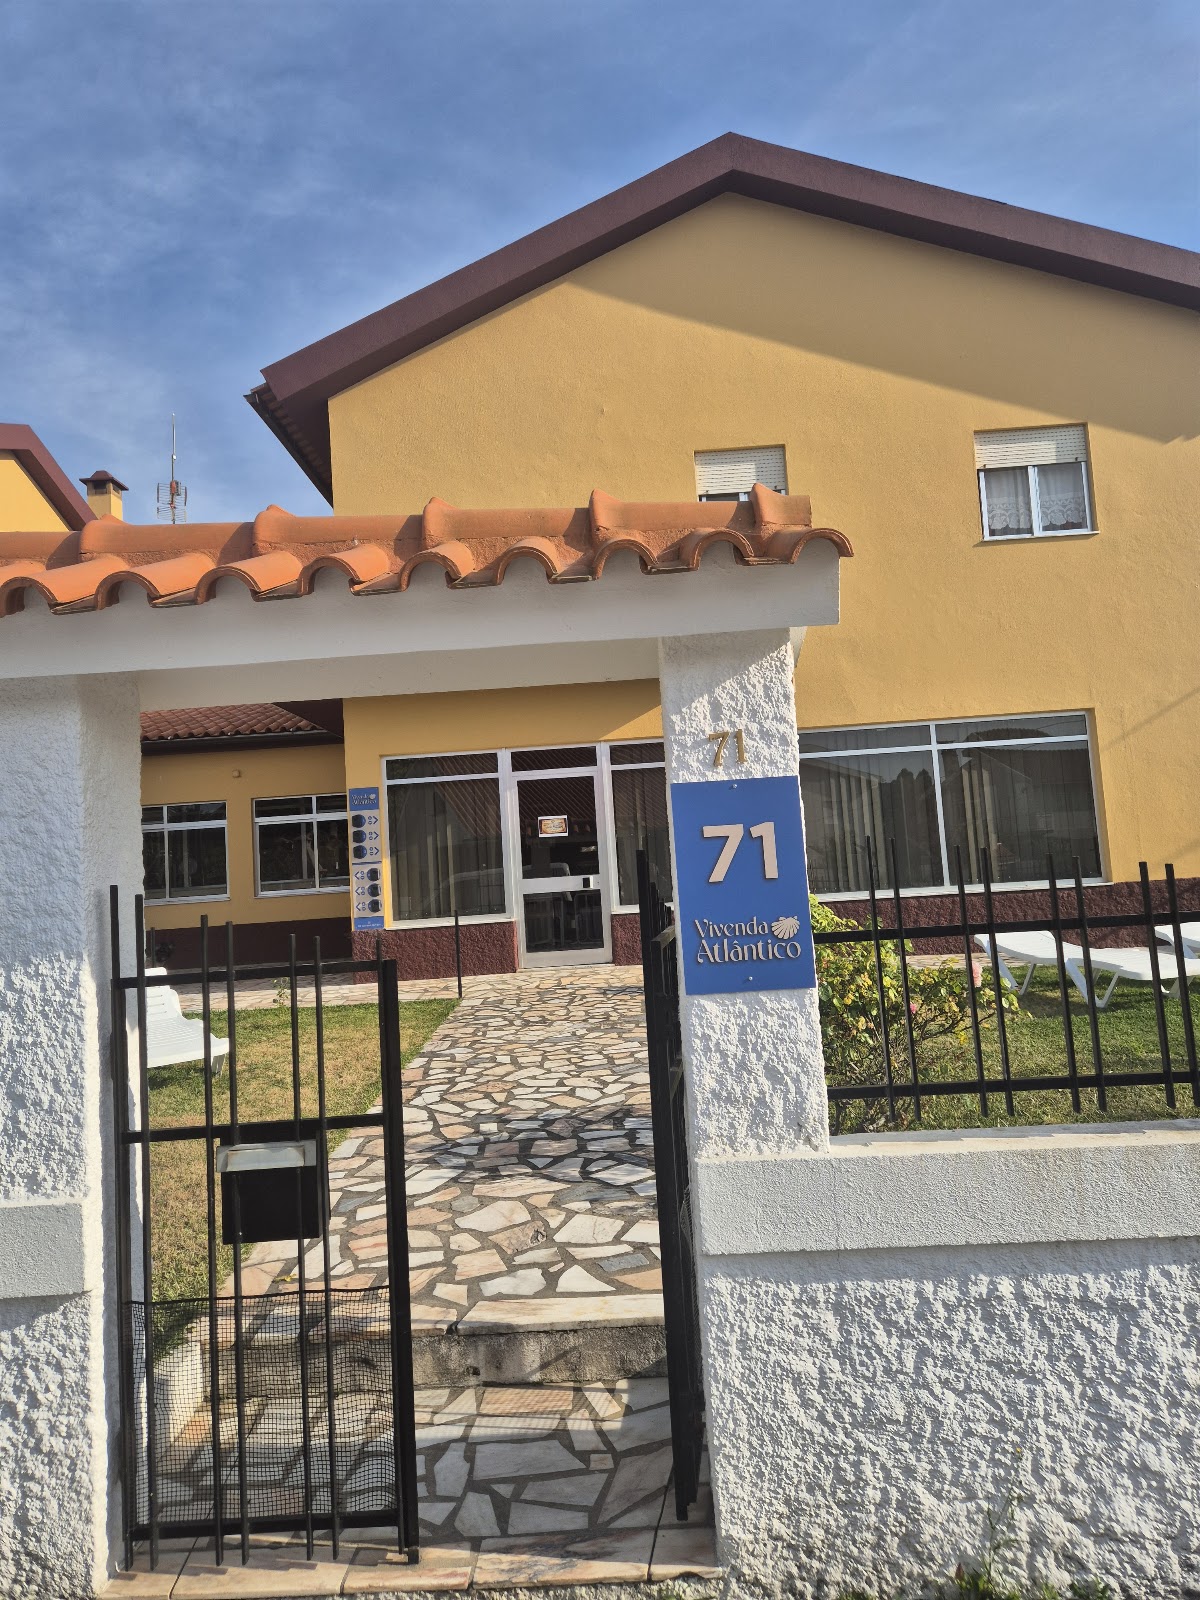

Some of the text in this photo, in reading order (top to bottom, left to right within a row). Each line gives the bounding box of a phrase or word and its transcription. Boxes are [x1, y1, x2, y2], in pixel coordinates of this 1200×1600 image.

[708, 728, 748, 767] 71
[702, 821, 779, 883] 71
[694, 916, 769, 938] Vivenda
[697, 938, 801, 964] Atlântico
